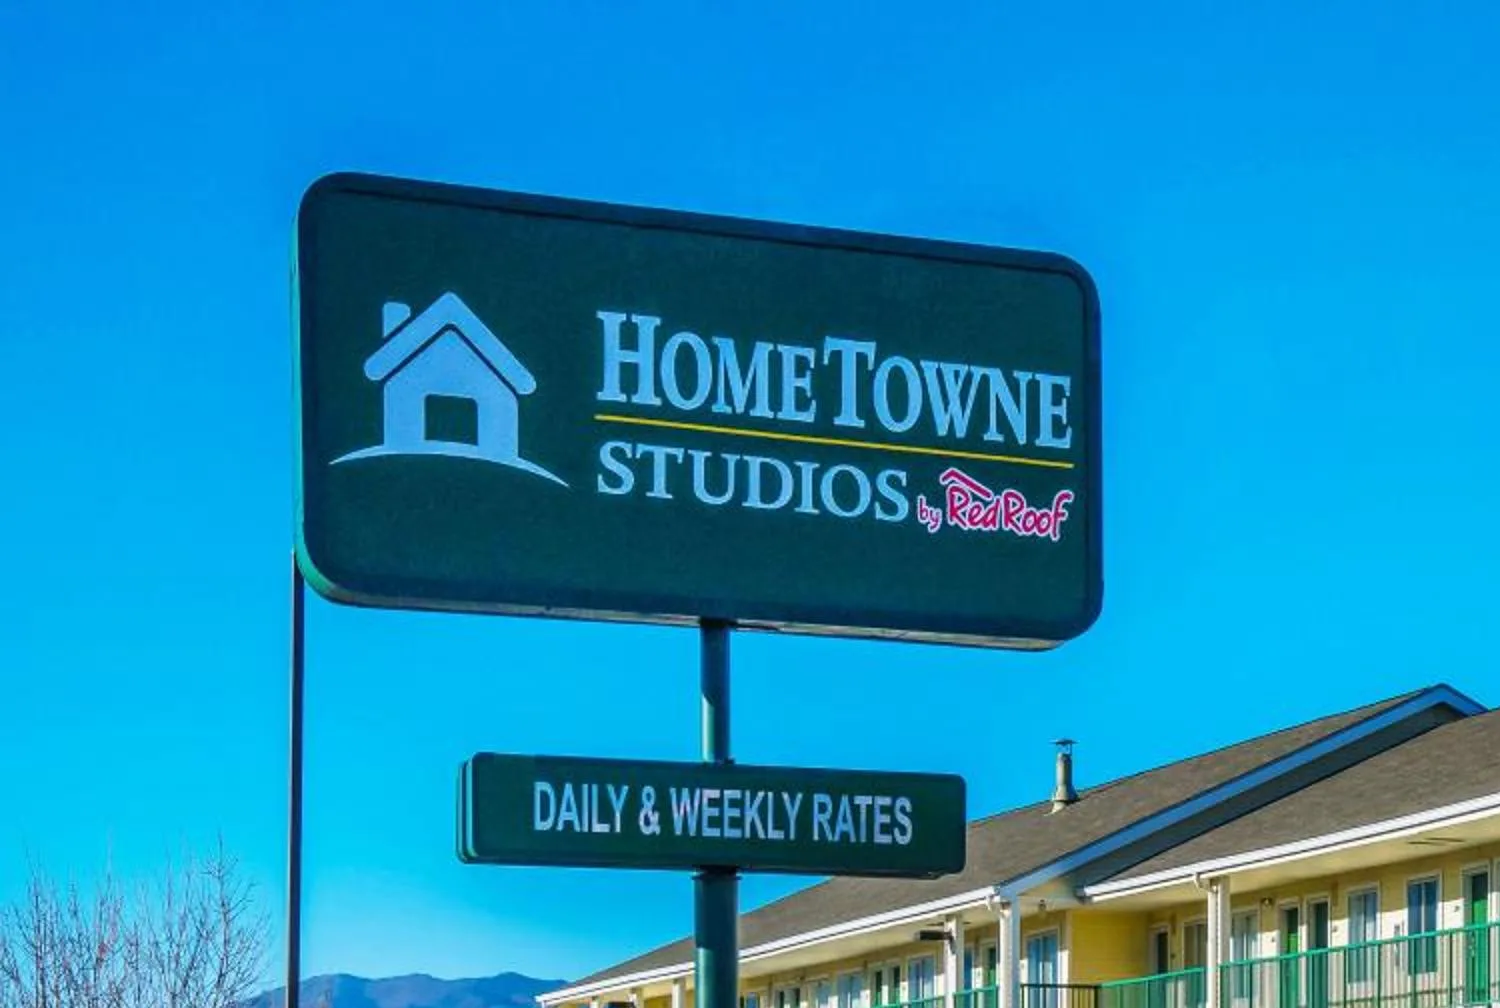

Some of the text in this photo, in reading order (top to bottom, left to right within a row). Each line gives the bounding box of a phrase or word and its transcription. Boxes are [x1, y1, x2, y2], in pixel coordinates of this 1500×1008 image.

[597, 441, 909, 521] STUDIOS
[917, 494, 943, 533] by
[533, 781, 914, 845] DAILY & WEEKLY RATES
